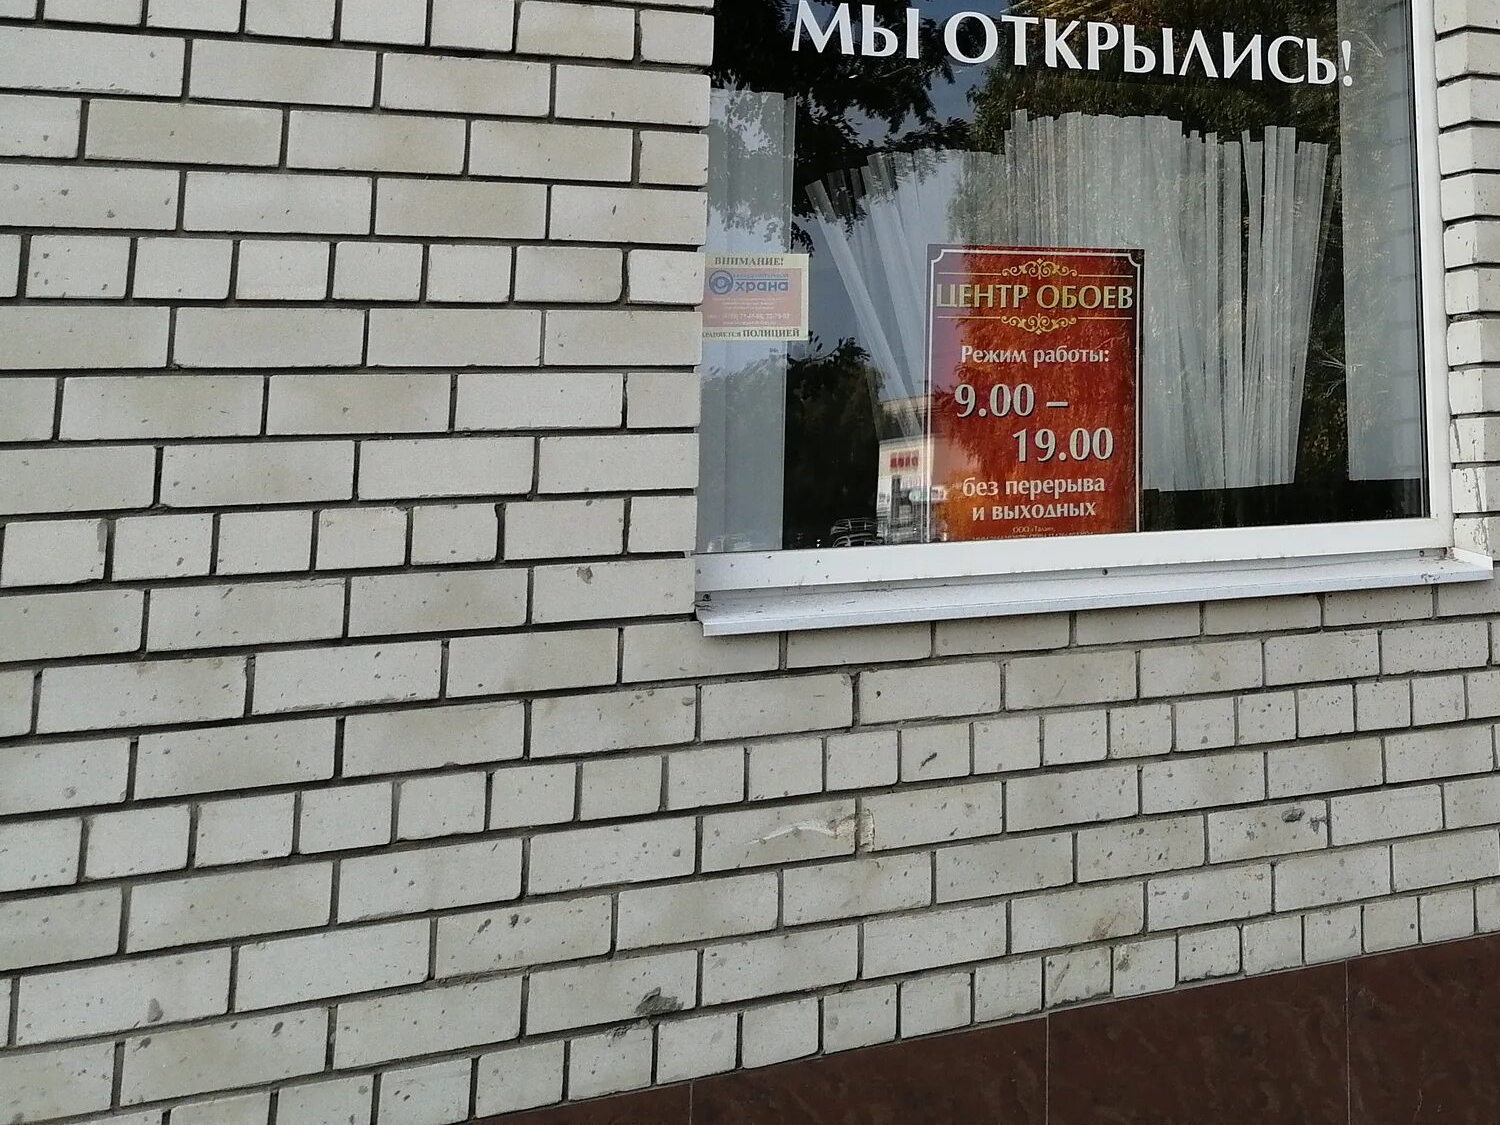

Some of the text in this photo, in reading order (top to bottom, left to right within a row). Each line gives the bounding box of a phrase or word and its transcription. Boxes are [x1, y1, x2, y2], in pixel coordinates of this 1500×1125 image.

[792, 0, 1353, 87] МЫ ОТКРЫЛИСЬ!
[714, 256, 784, 266] ВНИМАНИЕ!
[936, 283, 1133, 309] ЦЕНТР ОБОЕВ
[743, 328, 800, 338] ПОЛИЦИЕЙ
[961, 345, 1110, 368] Режим работы:
[954, 383, 1035, 418] 9.00
[1012, 427, 1114, 463] 19.00
[962, 477, 1105, 501] без перерыва
[992, 502, 1096, 521] выходных
